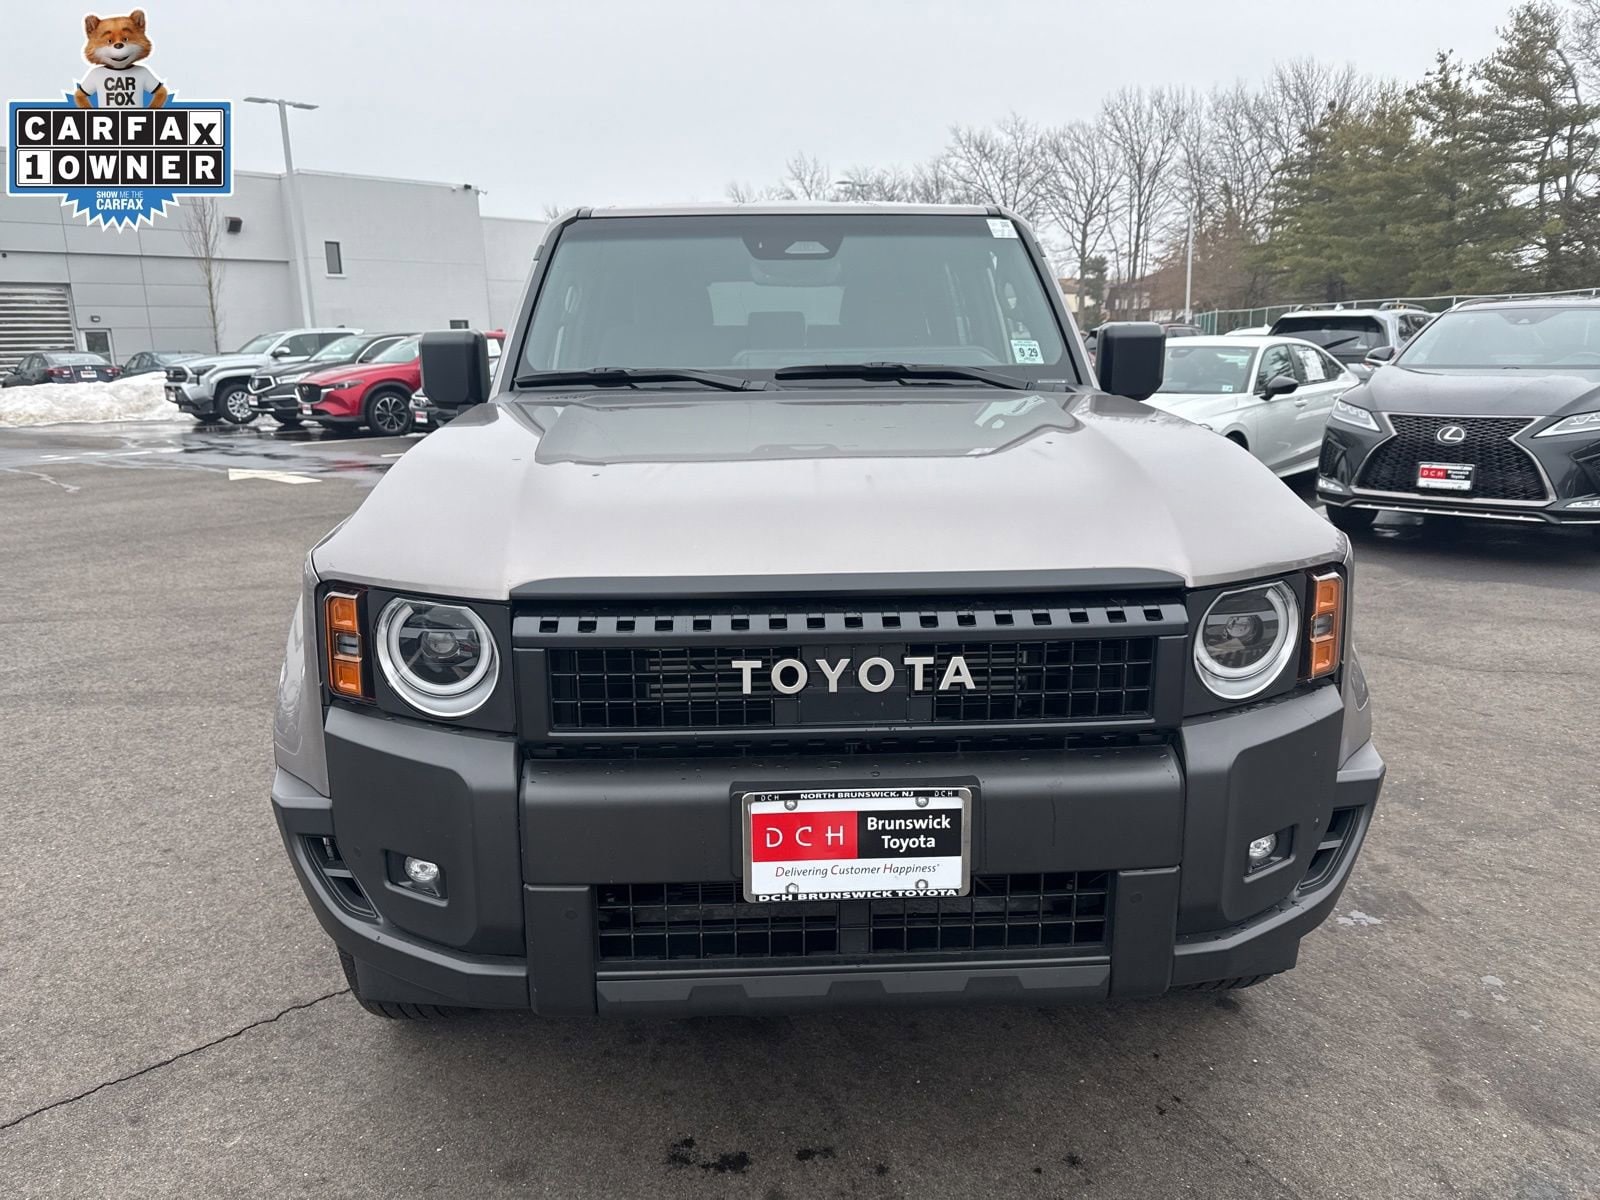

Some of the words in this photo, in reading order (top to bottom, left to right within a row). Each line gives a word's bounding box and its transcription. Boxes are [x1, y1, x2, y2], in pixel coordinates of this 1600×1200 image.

[731, 656, 976, 694] TOYOTA
[867, 814, 951, 831] Brunswick
[881, 835, 936, 853] Toyota
[775, 866, 828, 878] Delivering
[830, 864, 880, 875] Customer
[758, 894, 792, 902] DCH
[797, 889, 892, 900] BRUNSWICK
[896, 889, 957, 898] TOYOTA
